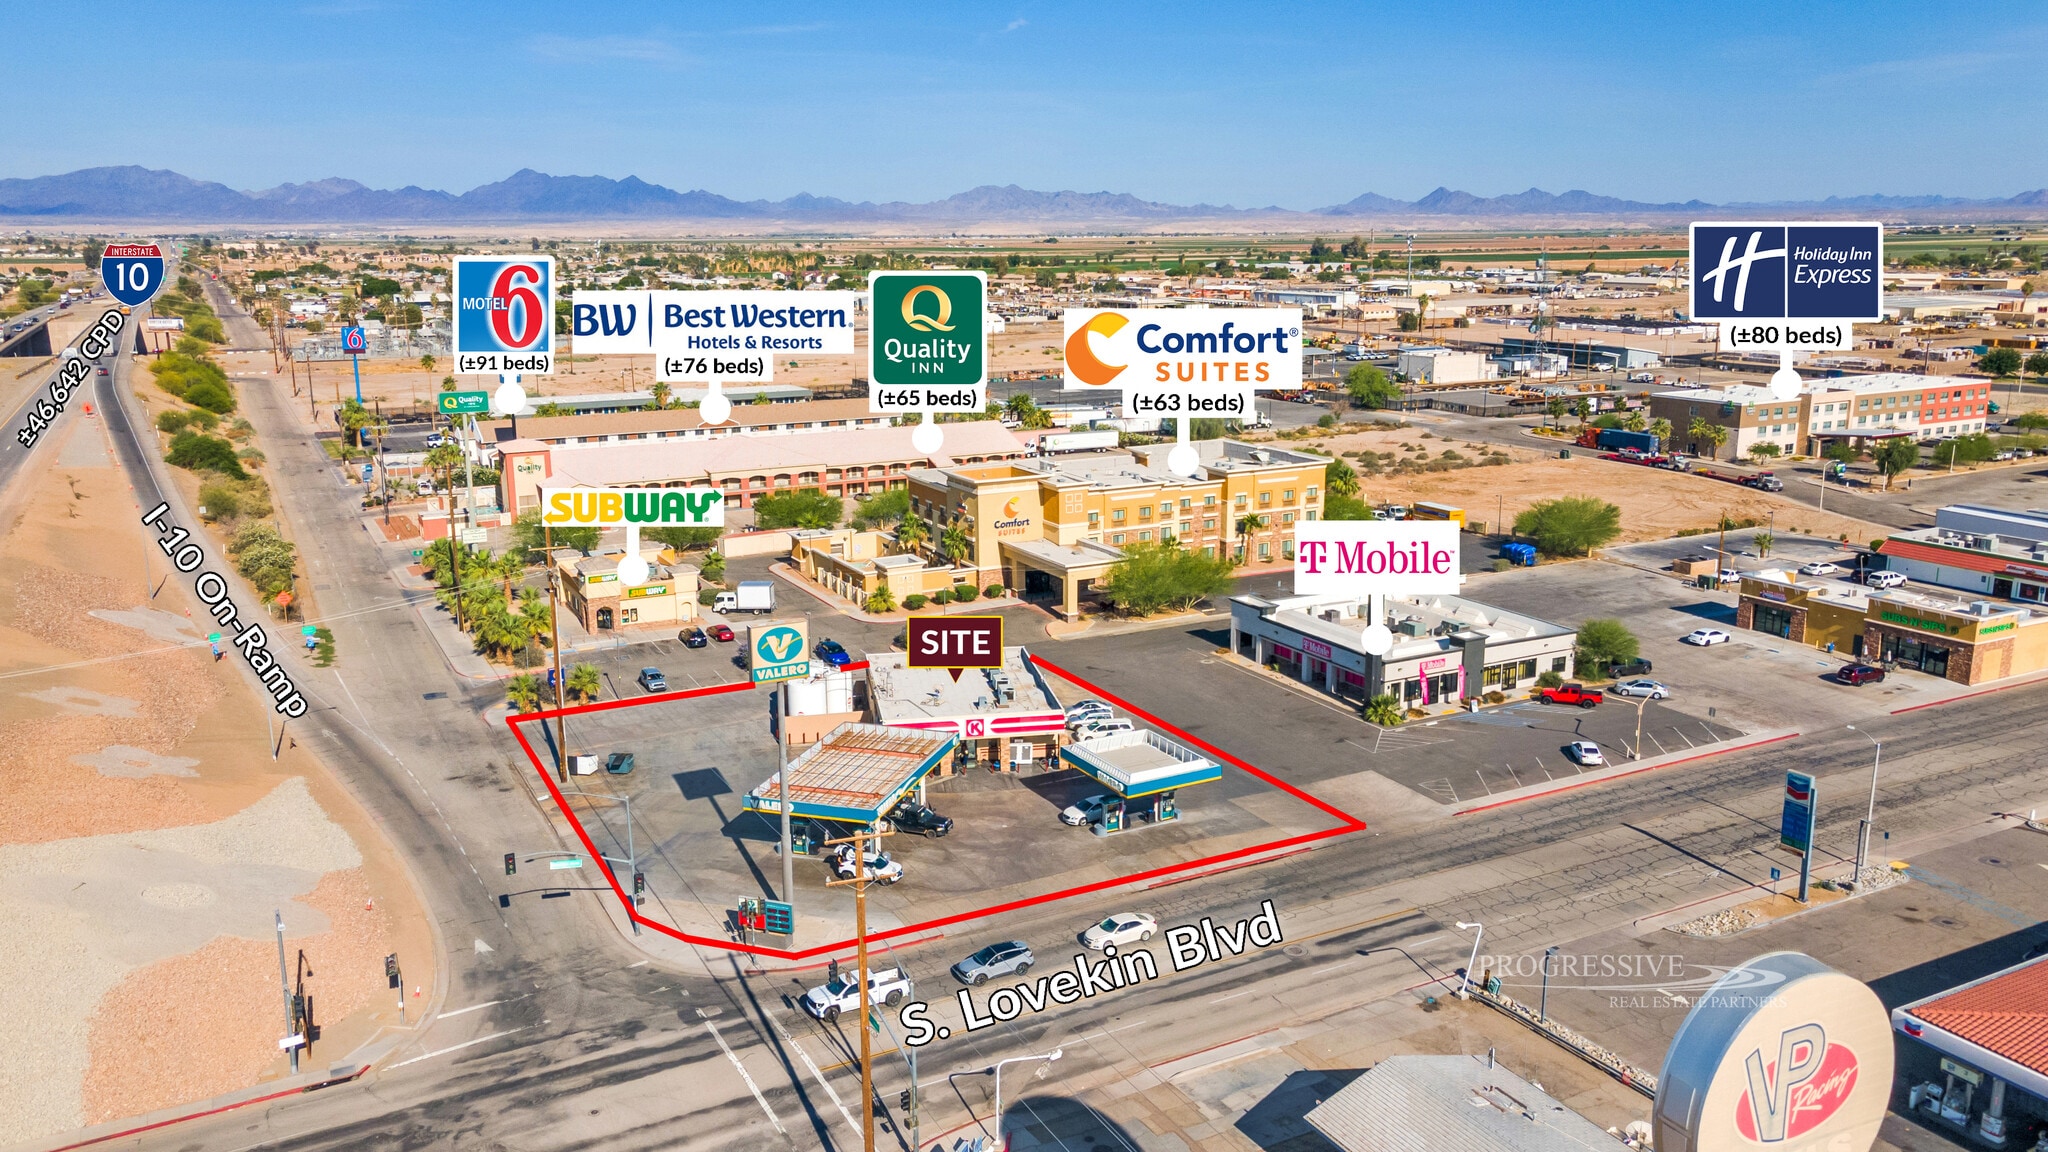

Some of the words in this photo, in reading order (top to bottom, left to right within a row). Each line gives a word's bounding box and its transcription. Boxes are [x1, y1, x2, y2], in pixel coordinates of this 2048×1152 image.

[347, 327, 363, 349] 6
[517, 463, 542, 473] Quality
[994, 518, 1030, 529] Comfort
[998, 528, 1026, 537] SUITES
[630, 586, 666, 598] SUBWAY
[1881, 611, 1909, 626] SUBS
[1921, 620, 1947, 633] SIPS
[756, 664, 807, 681] VALERO
[970, 721, 984, 735] K
[1745, 1022, 1826, 1143] VP
[1791, 1064, 1859, 1125] Racing
